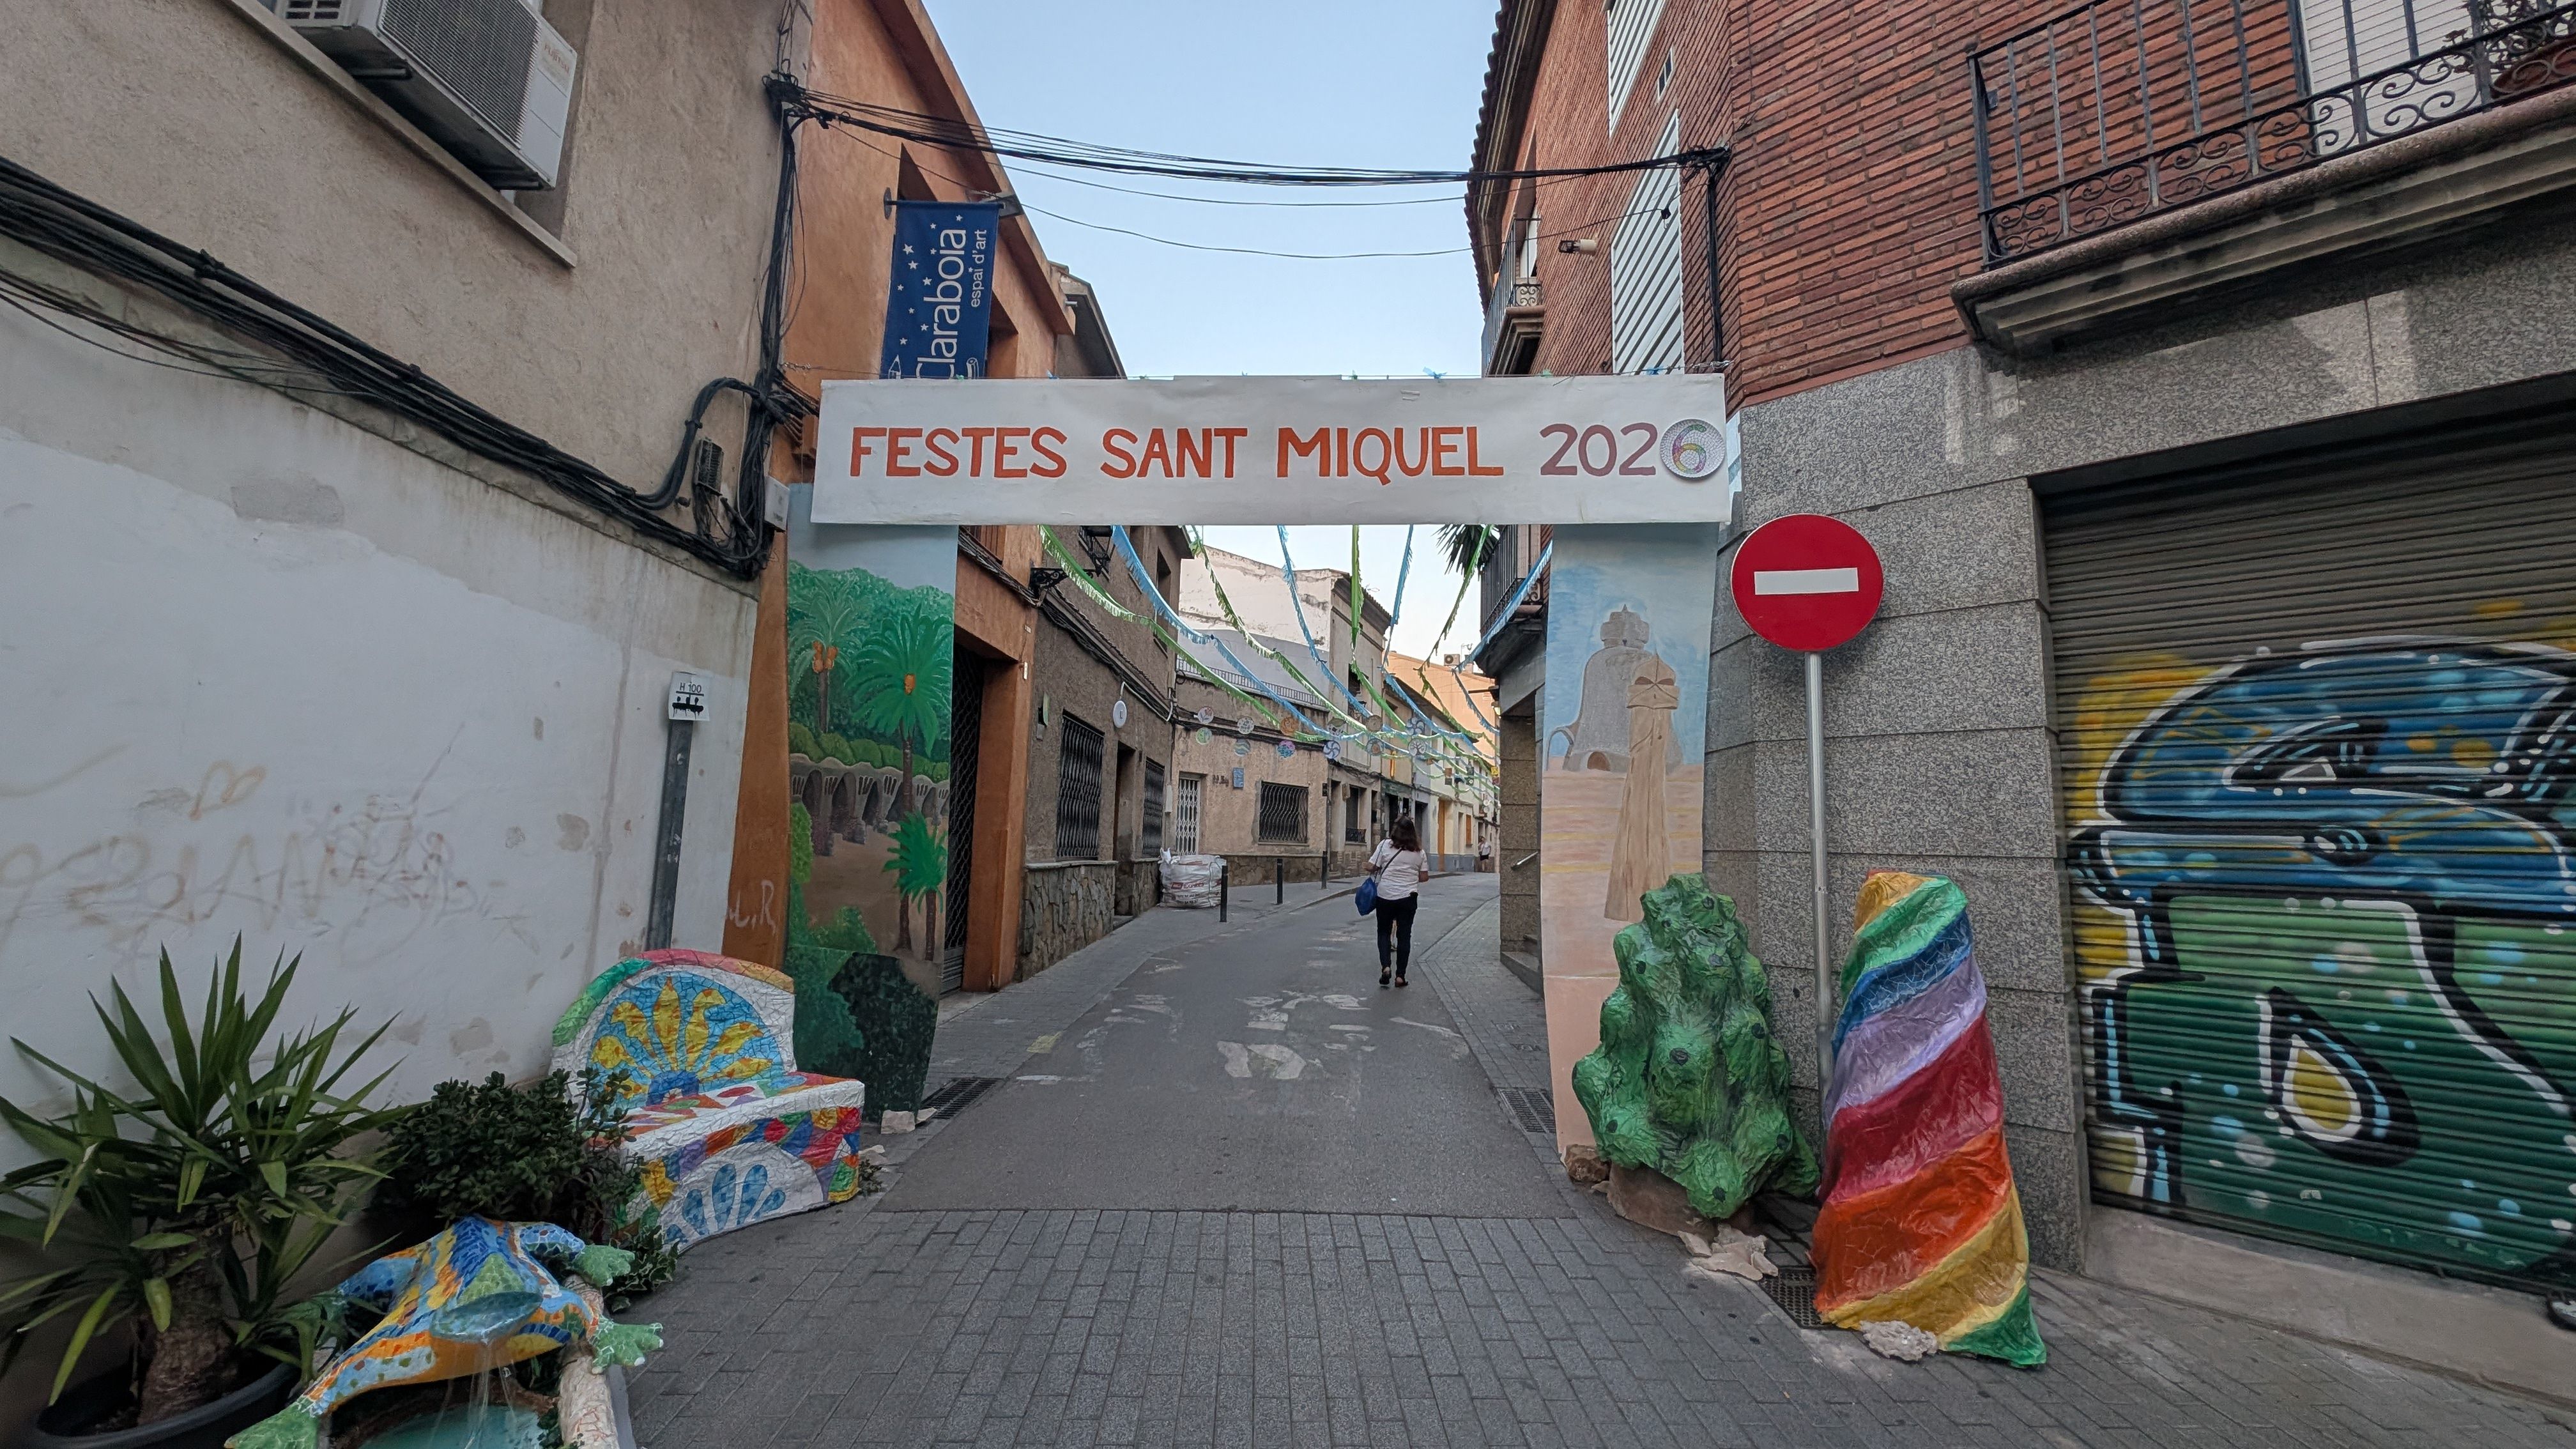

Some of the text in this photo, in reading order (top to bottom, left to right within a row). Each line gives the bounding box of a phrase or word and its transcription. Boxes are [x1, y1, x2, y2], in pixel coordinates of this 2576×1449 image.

[970, 229, 987, 308] espai d'art
[849, 422, 1708, 486] FESTES SANT MIQUEL 2026
[680, 682, 702, 693] H 100
